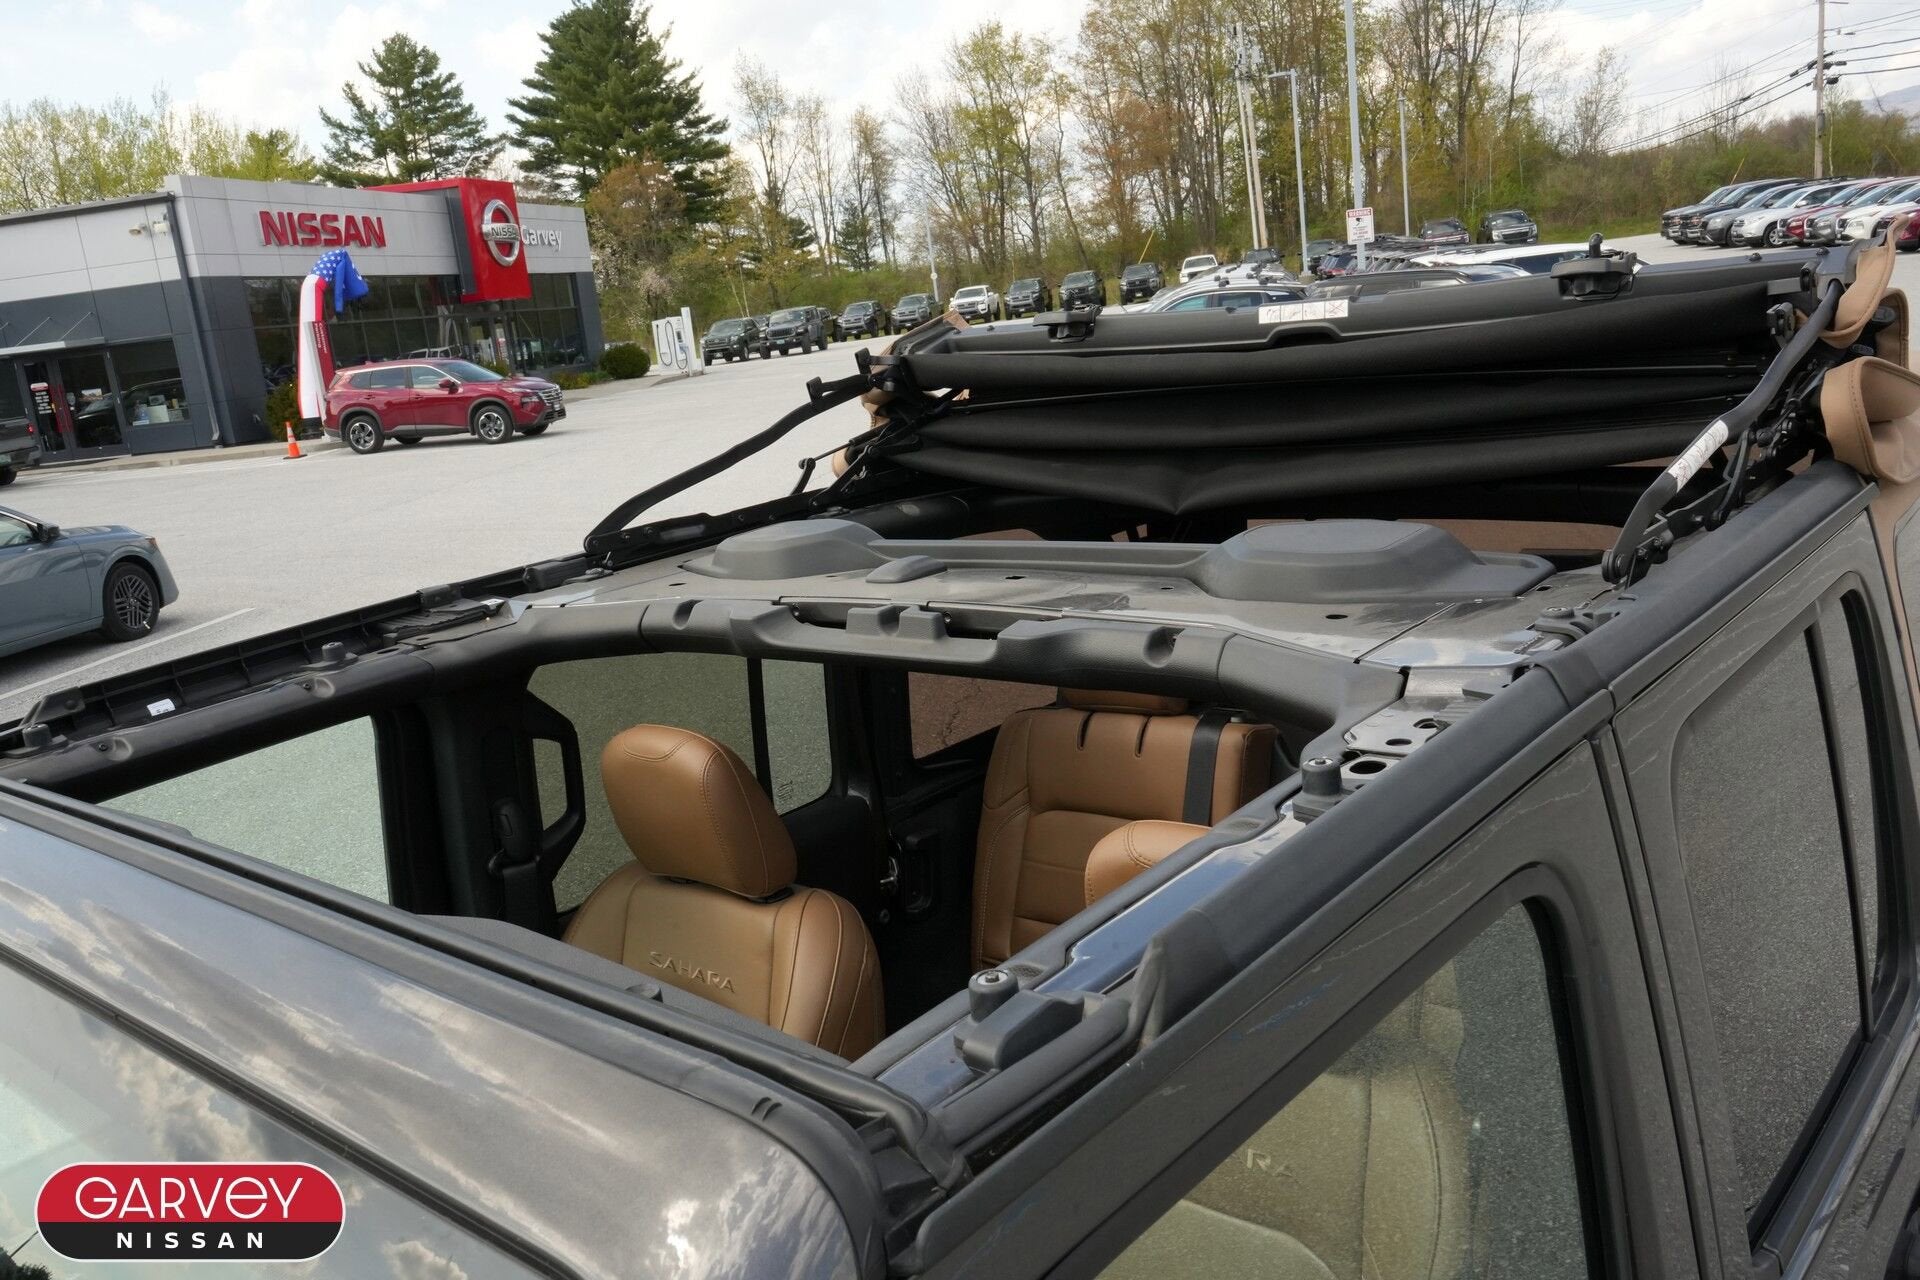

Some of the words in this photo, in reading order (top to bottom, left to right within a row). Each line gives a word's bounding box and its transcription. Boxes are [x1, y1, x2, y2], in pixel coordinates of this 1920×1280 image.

[259, 211, 386, 248] NISSAN
[520, 225, 562, 251] Garvey
[648, 951, 735, 994] SAHARA
